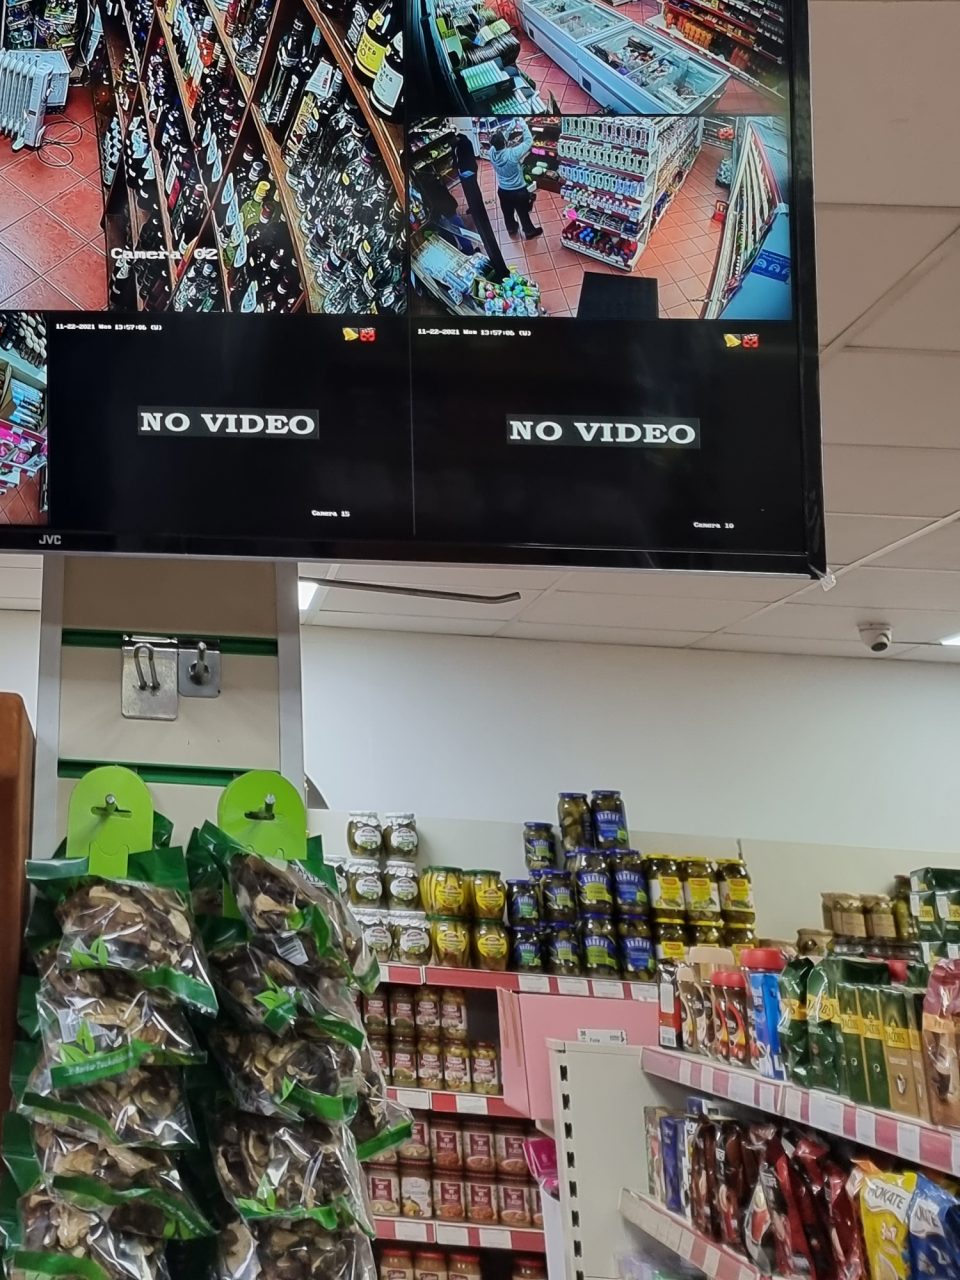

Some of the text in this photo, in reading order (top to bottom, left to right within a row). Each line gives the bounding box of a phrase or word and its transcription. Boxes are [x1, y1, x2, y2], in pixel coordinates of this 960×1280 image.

[110, 247, 218, 260] Camera 02
[140, 412, 315, 435] NO VIDEO
[509, 420, 696, 445] NO VIDEO
[311, 509, 338, 517] Camera
[693, 521, 721, 529] Camera
[38, 534, 62, 545] JVC
